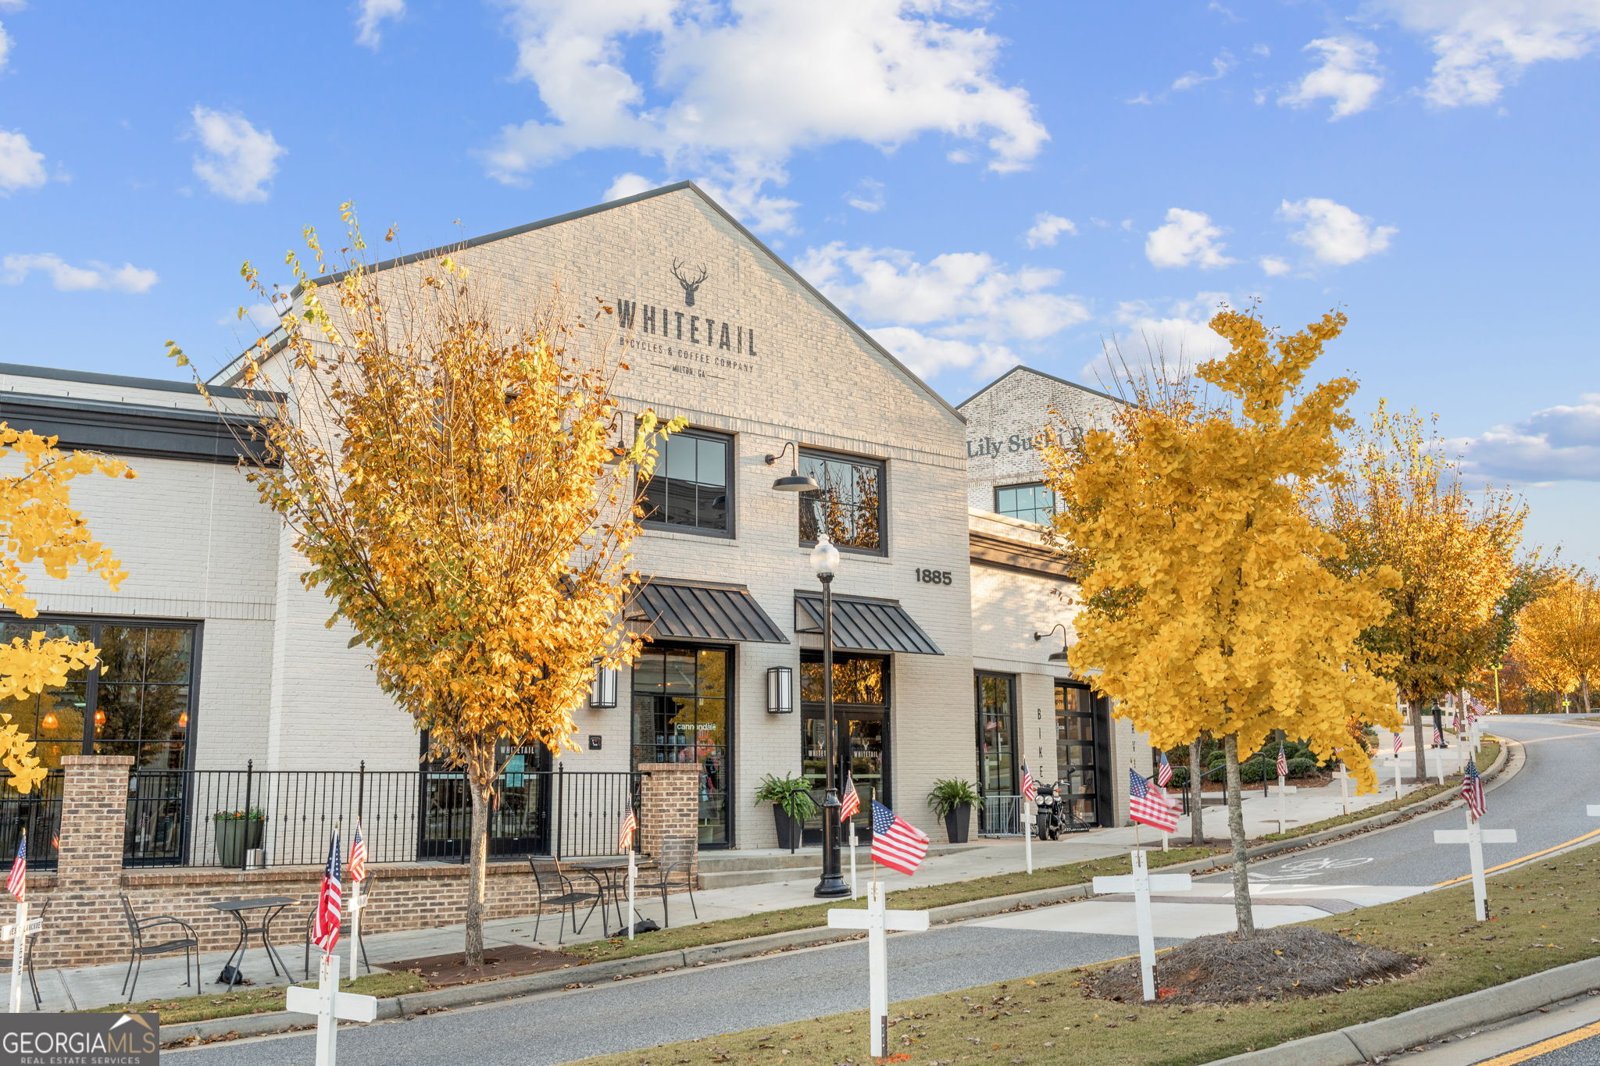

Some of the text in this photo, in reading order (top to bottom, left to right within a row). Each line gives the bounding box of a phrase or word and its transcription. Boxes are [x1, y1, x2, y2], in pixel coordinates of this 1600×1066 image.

[617, 298, 757, 356] WHITETAIL
[619, 336, 754, 373] BCYCLES & COFFEE COMPANY
[697, 369, 706, 378] GA
[966, 436, 1003, 459] Lily
[915, 568, 952, 585] 1885
[677, 722, 716, 730] cannndale
